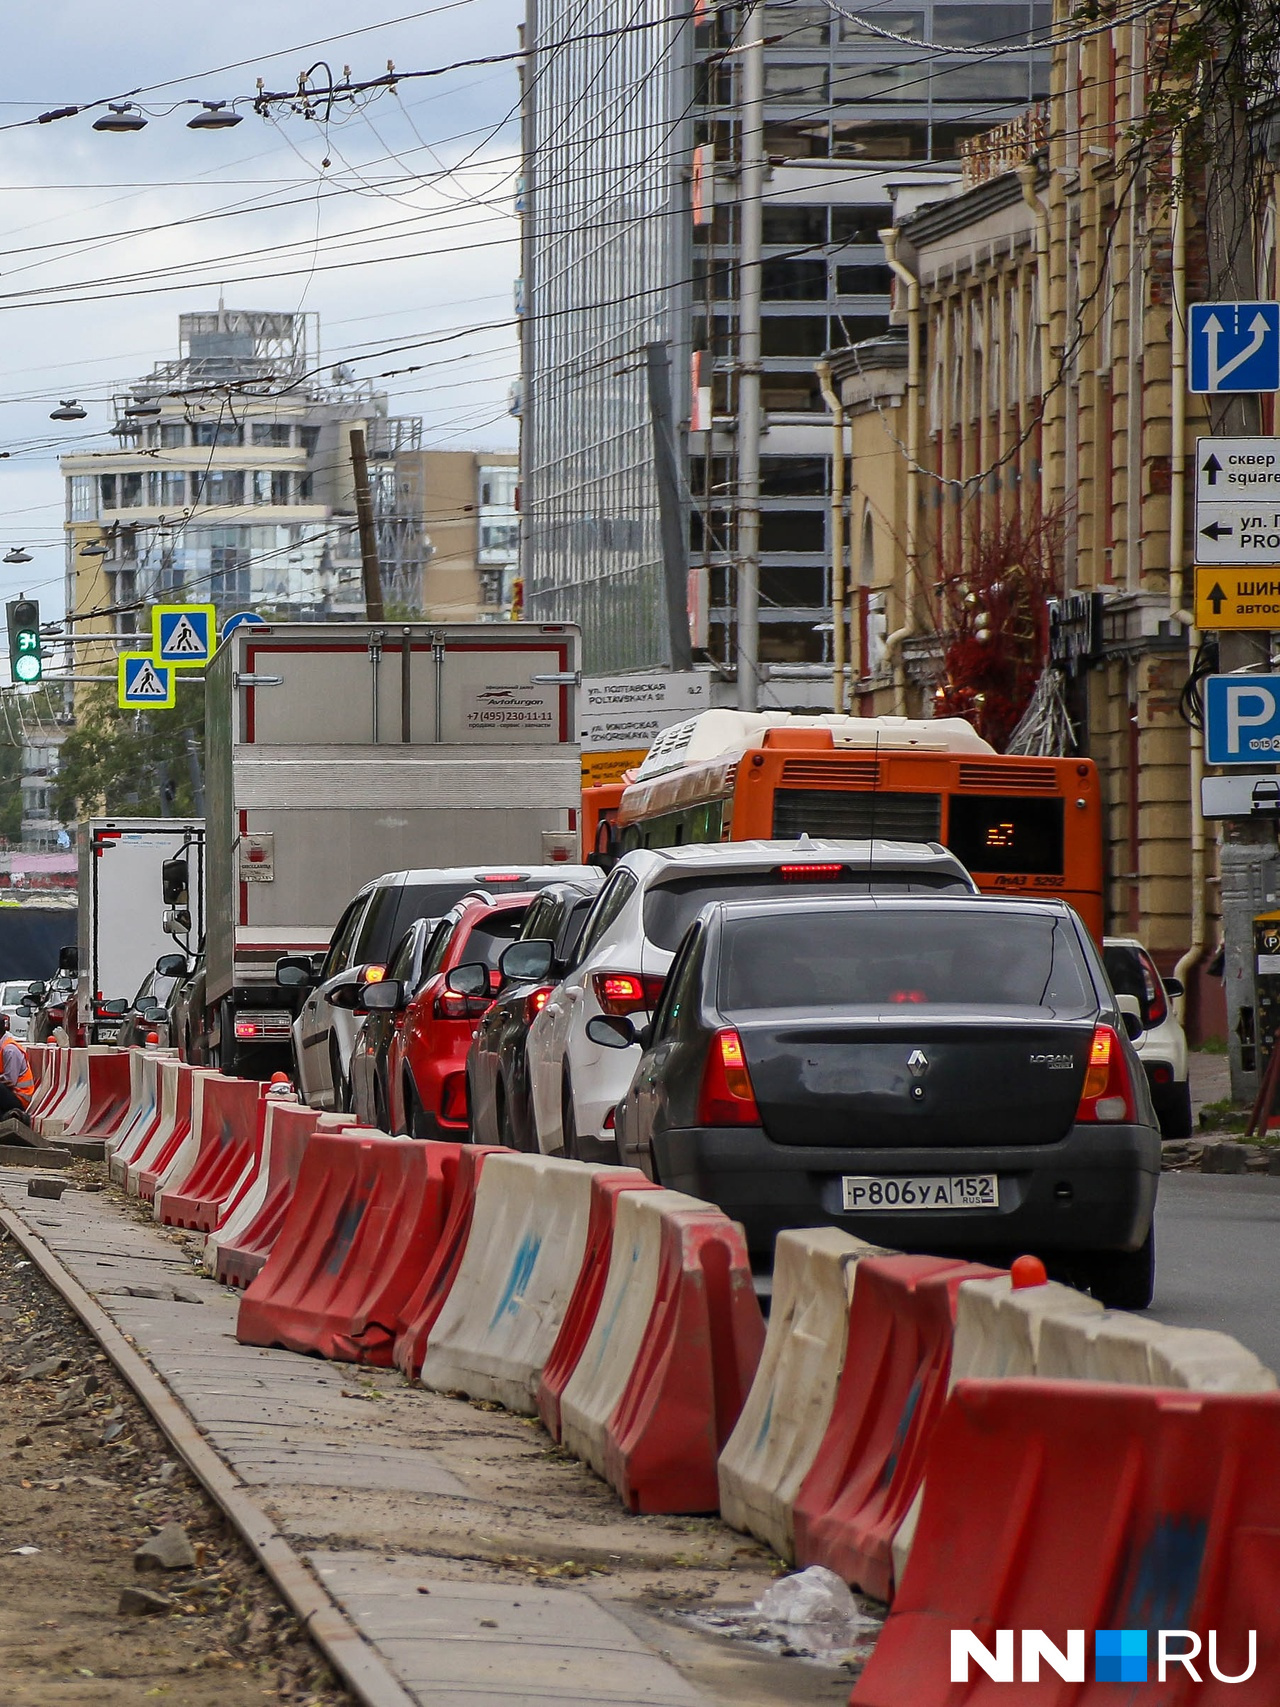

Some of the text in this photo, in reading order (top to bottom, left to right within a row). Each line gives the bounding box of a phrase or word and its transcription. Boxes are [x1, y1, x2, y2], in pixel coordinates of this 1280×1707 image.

[1228, 455, 1275, 467] сквер
[1228, 473, 1280, 485] square
[1240, 517, 1267, 531] ул.
[1241, 534, 1280, 548] PRO
[1237, 582, 1280, 596] ШИН
[1236, 604, 1280, 614] автос
[20, 633, 36, 649] 34
[954, 1178, 990, 1196] 152
